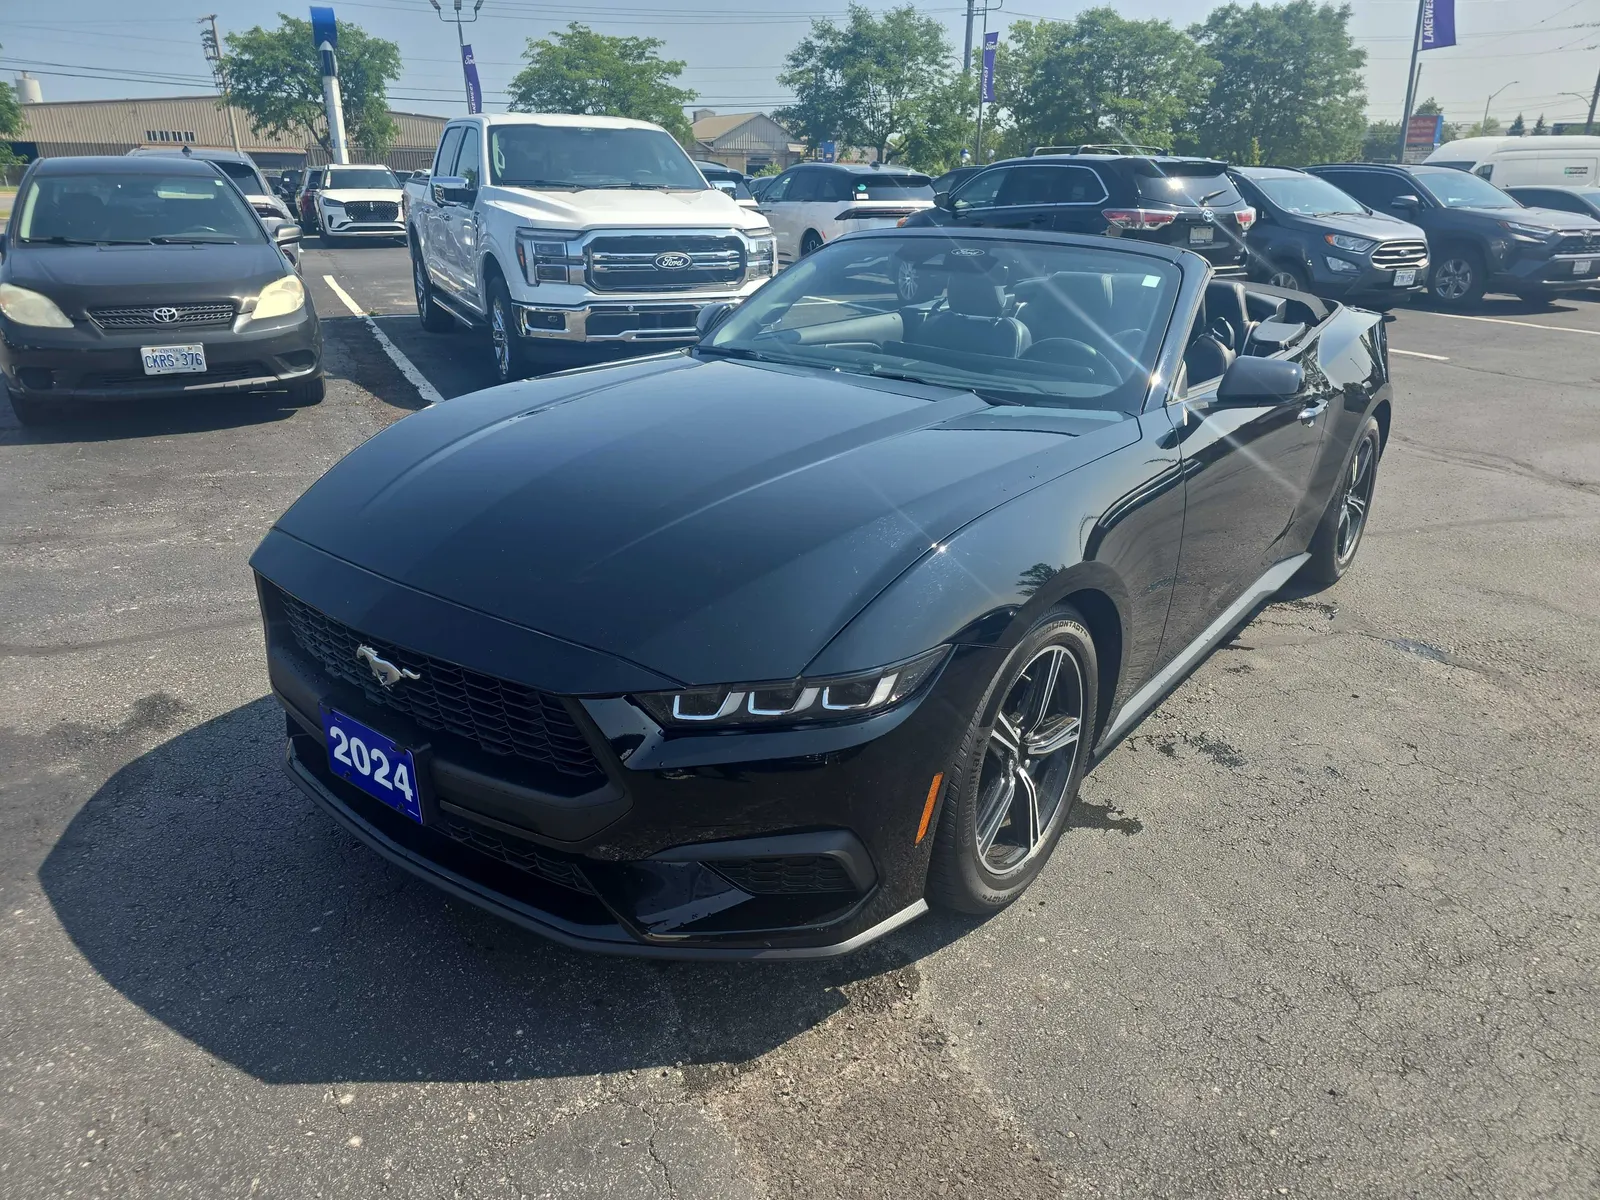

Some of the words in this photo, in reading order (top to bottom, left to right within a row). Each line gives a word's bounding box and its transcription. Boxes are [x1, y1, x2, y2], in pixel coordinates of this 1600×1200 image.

[145, 354, 175, 369] CKRS
[181, 352, 203, 366] 376
[329, 726, 414, 803] 2024
